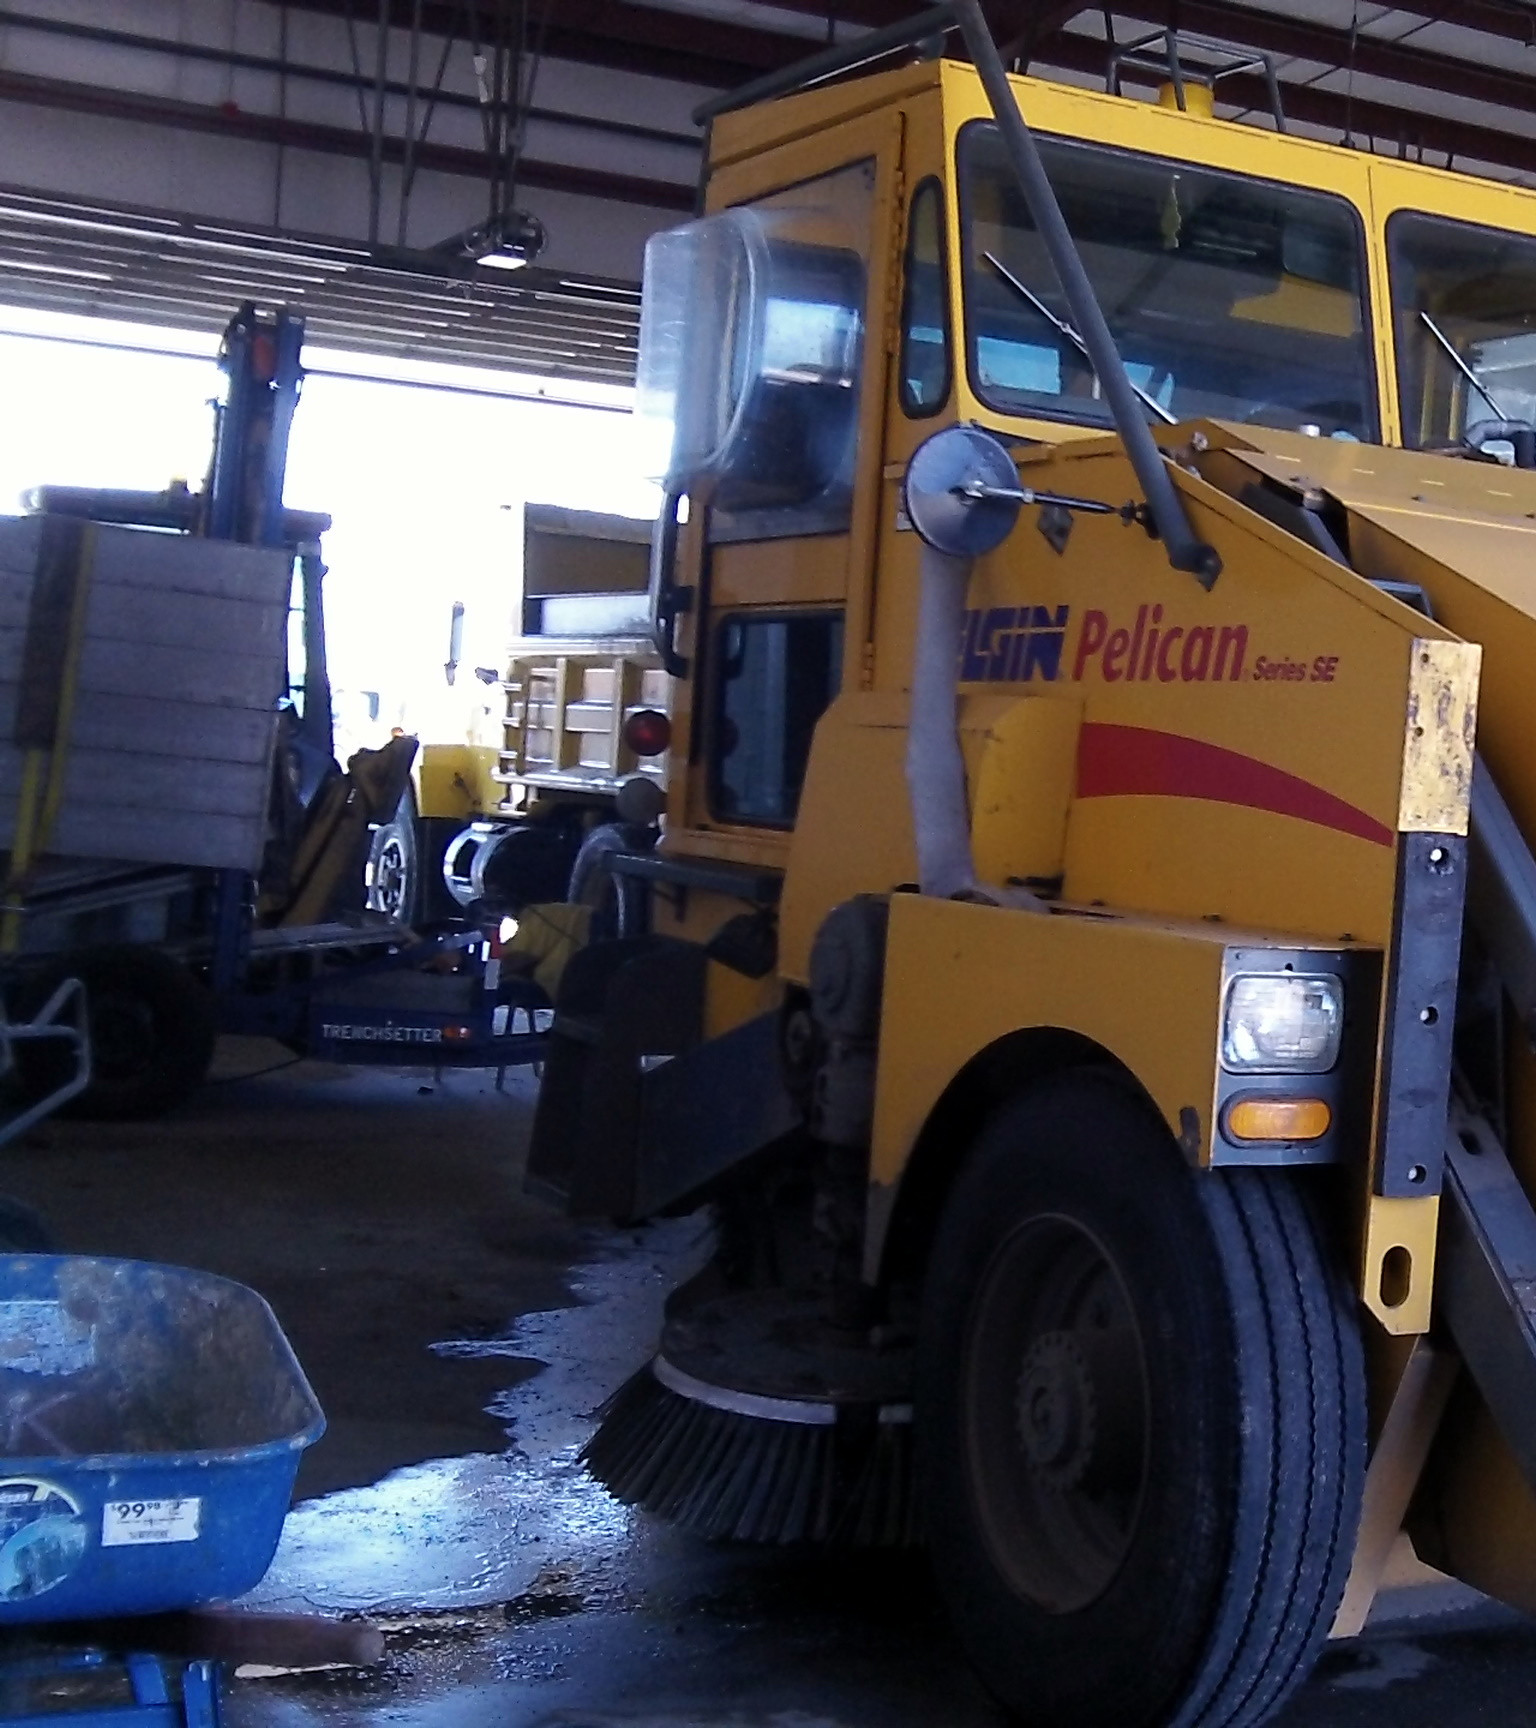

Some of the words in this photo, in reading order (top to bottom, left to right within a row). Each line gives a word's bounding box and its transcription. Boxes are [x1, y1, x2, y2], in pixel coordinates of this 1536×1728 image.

[958, 604, 1070, 682] LGIN
[1071, 603, 1250, 683] Pelican
[1253, 655, 1307, 682] Series
[1310, 656, 1340, 682] SE
[322, 1023, 442, 1042] TRENCHSETTER
